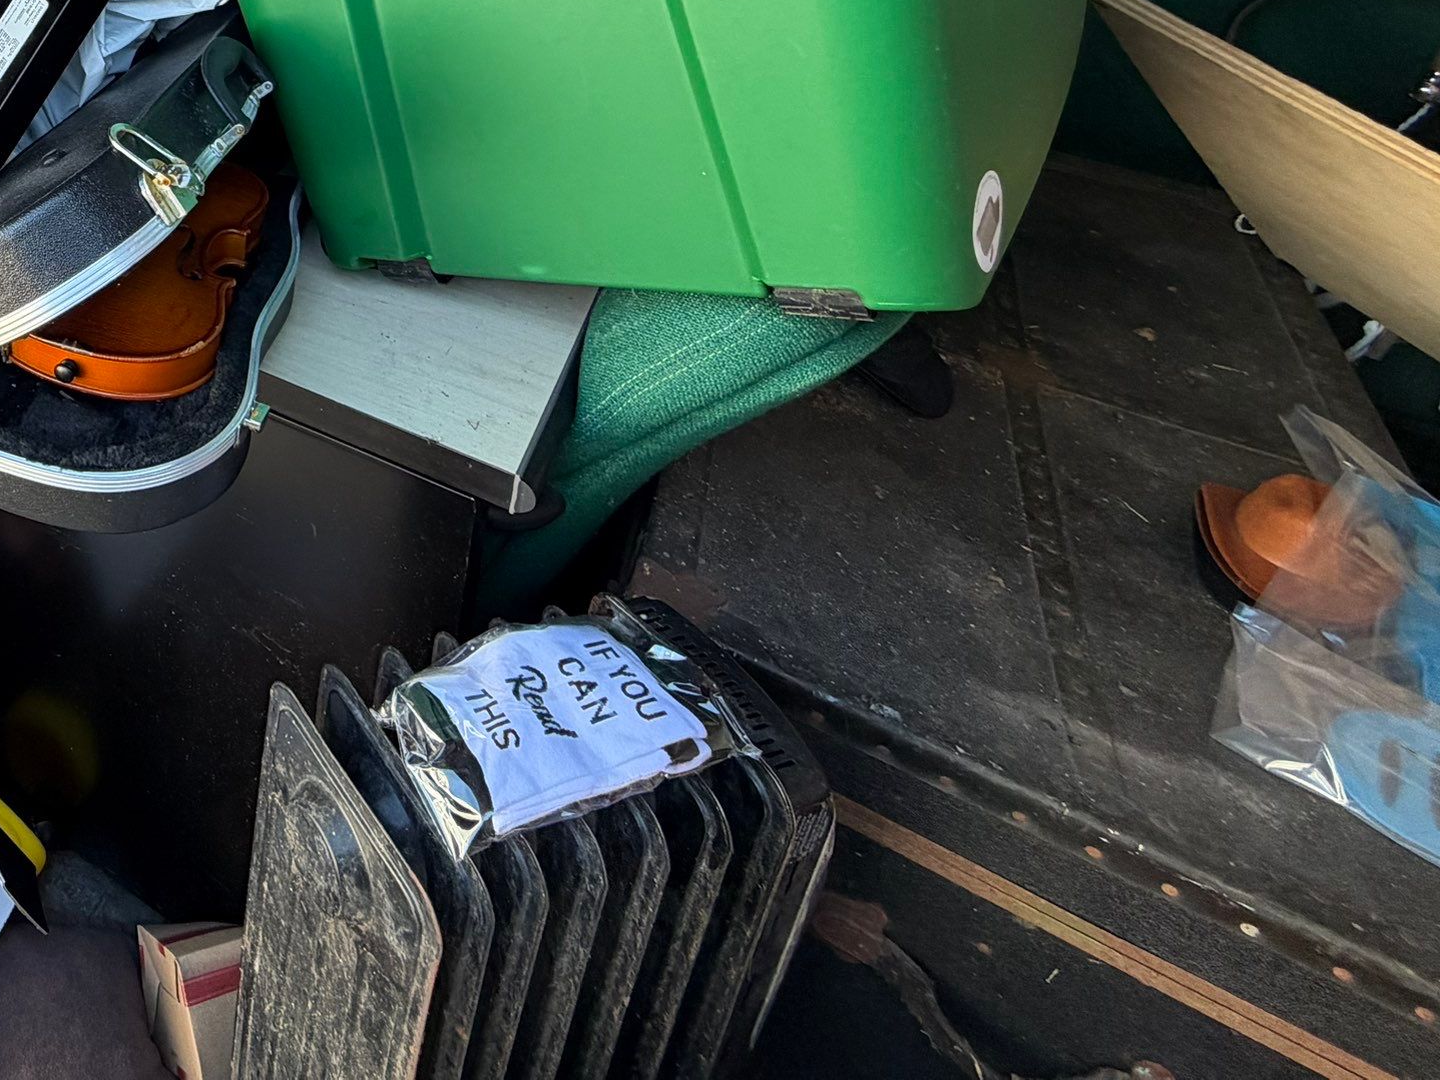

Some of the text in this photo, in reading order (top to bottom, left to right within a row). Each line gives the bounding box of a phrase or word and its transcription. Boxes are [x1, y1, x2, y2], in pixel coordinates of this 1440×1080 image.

[504, 665, 580, 741] Read
[557, 657, 619, 725] CAN
[583, 639, 667, 722] IF YOU
[464, 688, 521, 752] THIS
